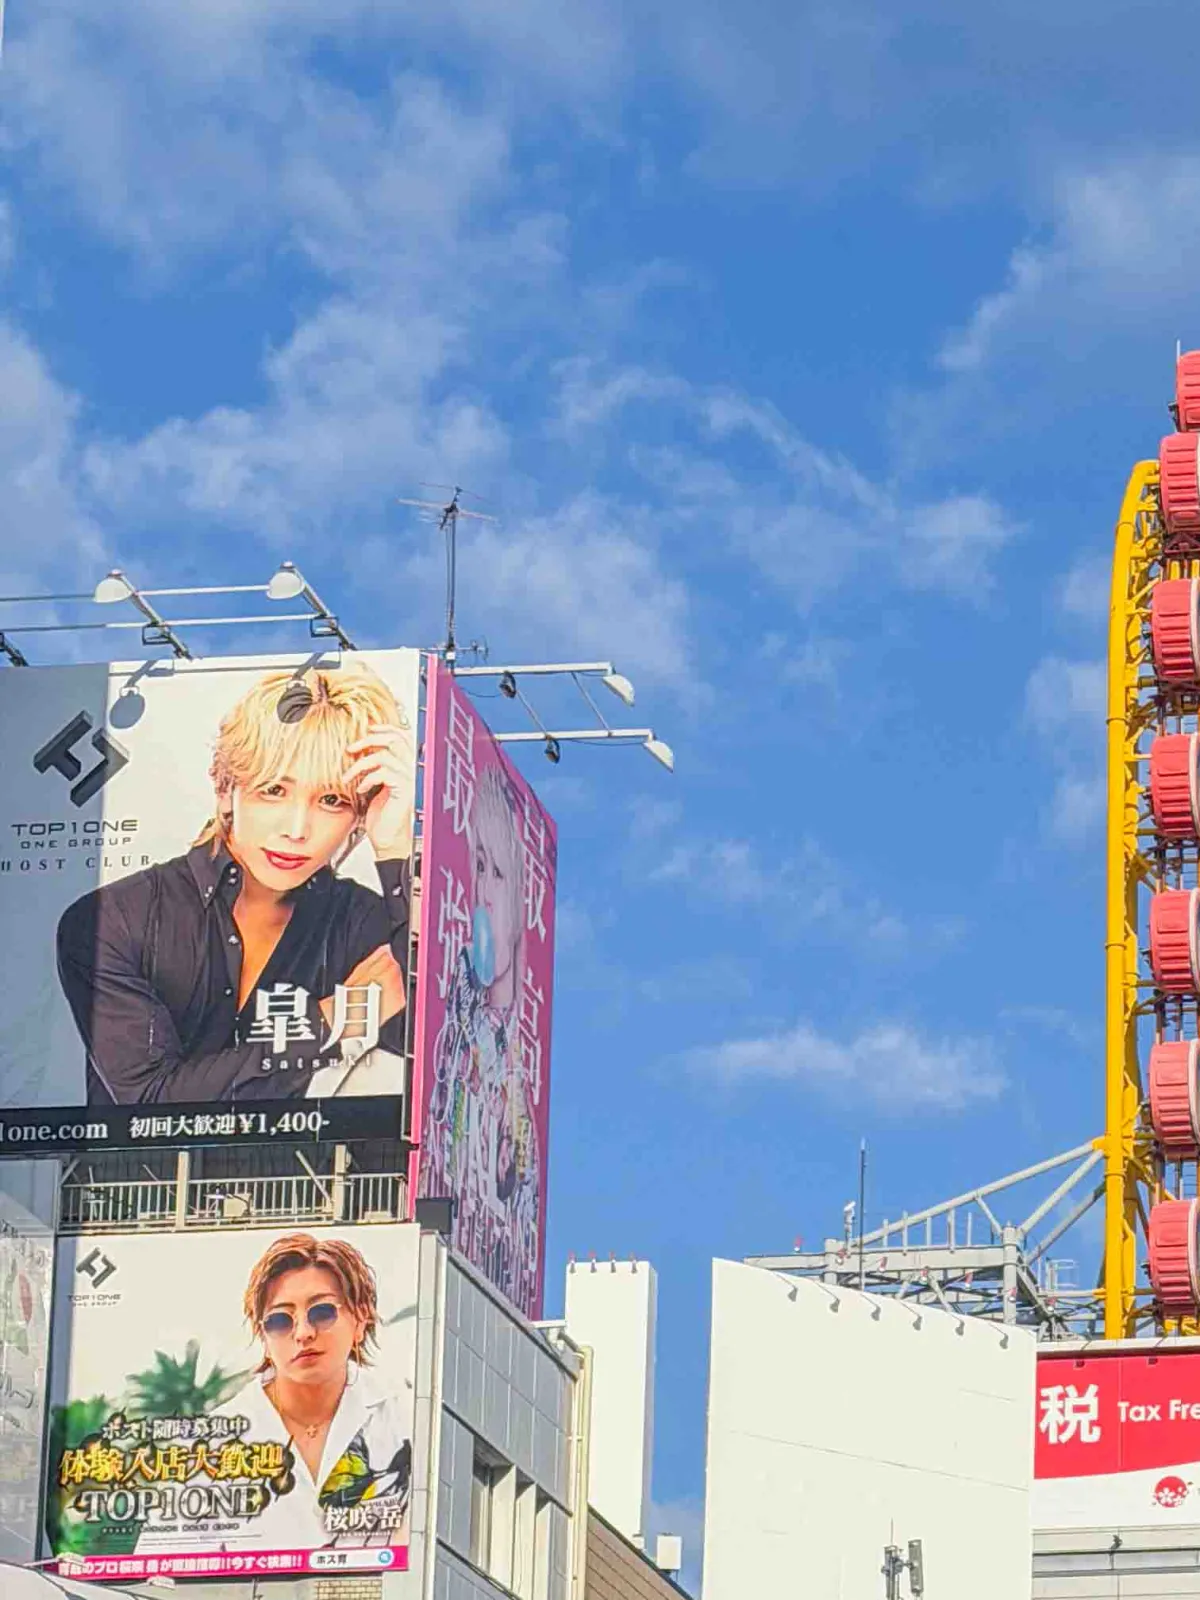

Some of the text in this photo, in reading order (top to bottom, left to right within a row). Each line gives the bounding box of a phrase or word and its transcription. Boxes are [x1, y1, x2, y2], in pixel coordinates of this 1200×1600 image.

[11, 820, 138, 837] TOP1ONE
[21, 837, 132, 849] ONE GROUP
[1, 855, 151, 872] HOST CLUB
[1039, 1385, 1101, 1444] 税
[1118, 1402, 1161, 1424] Tax
